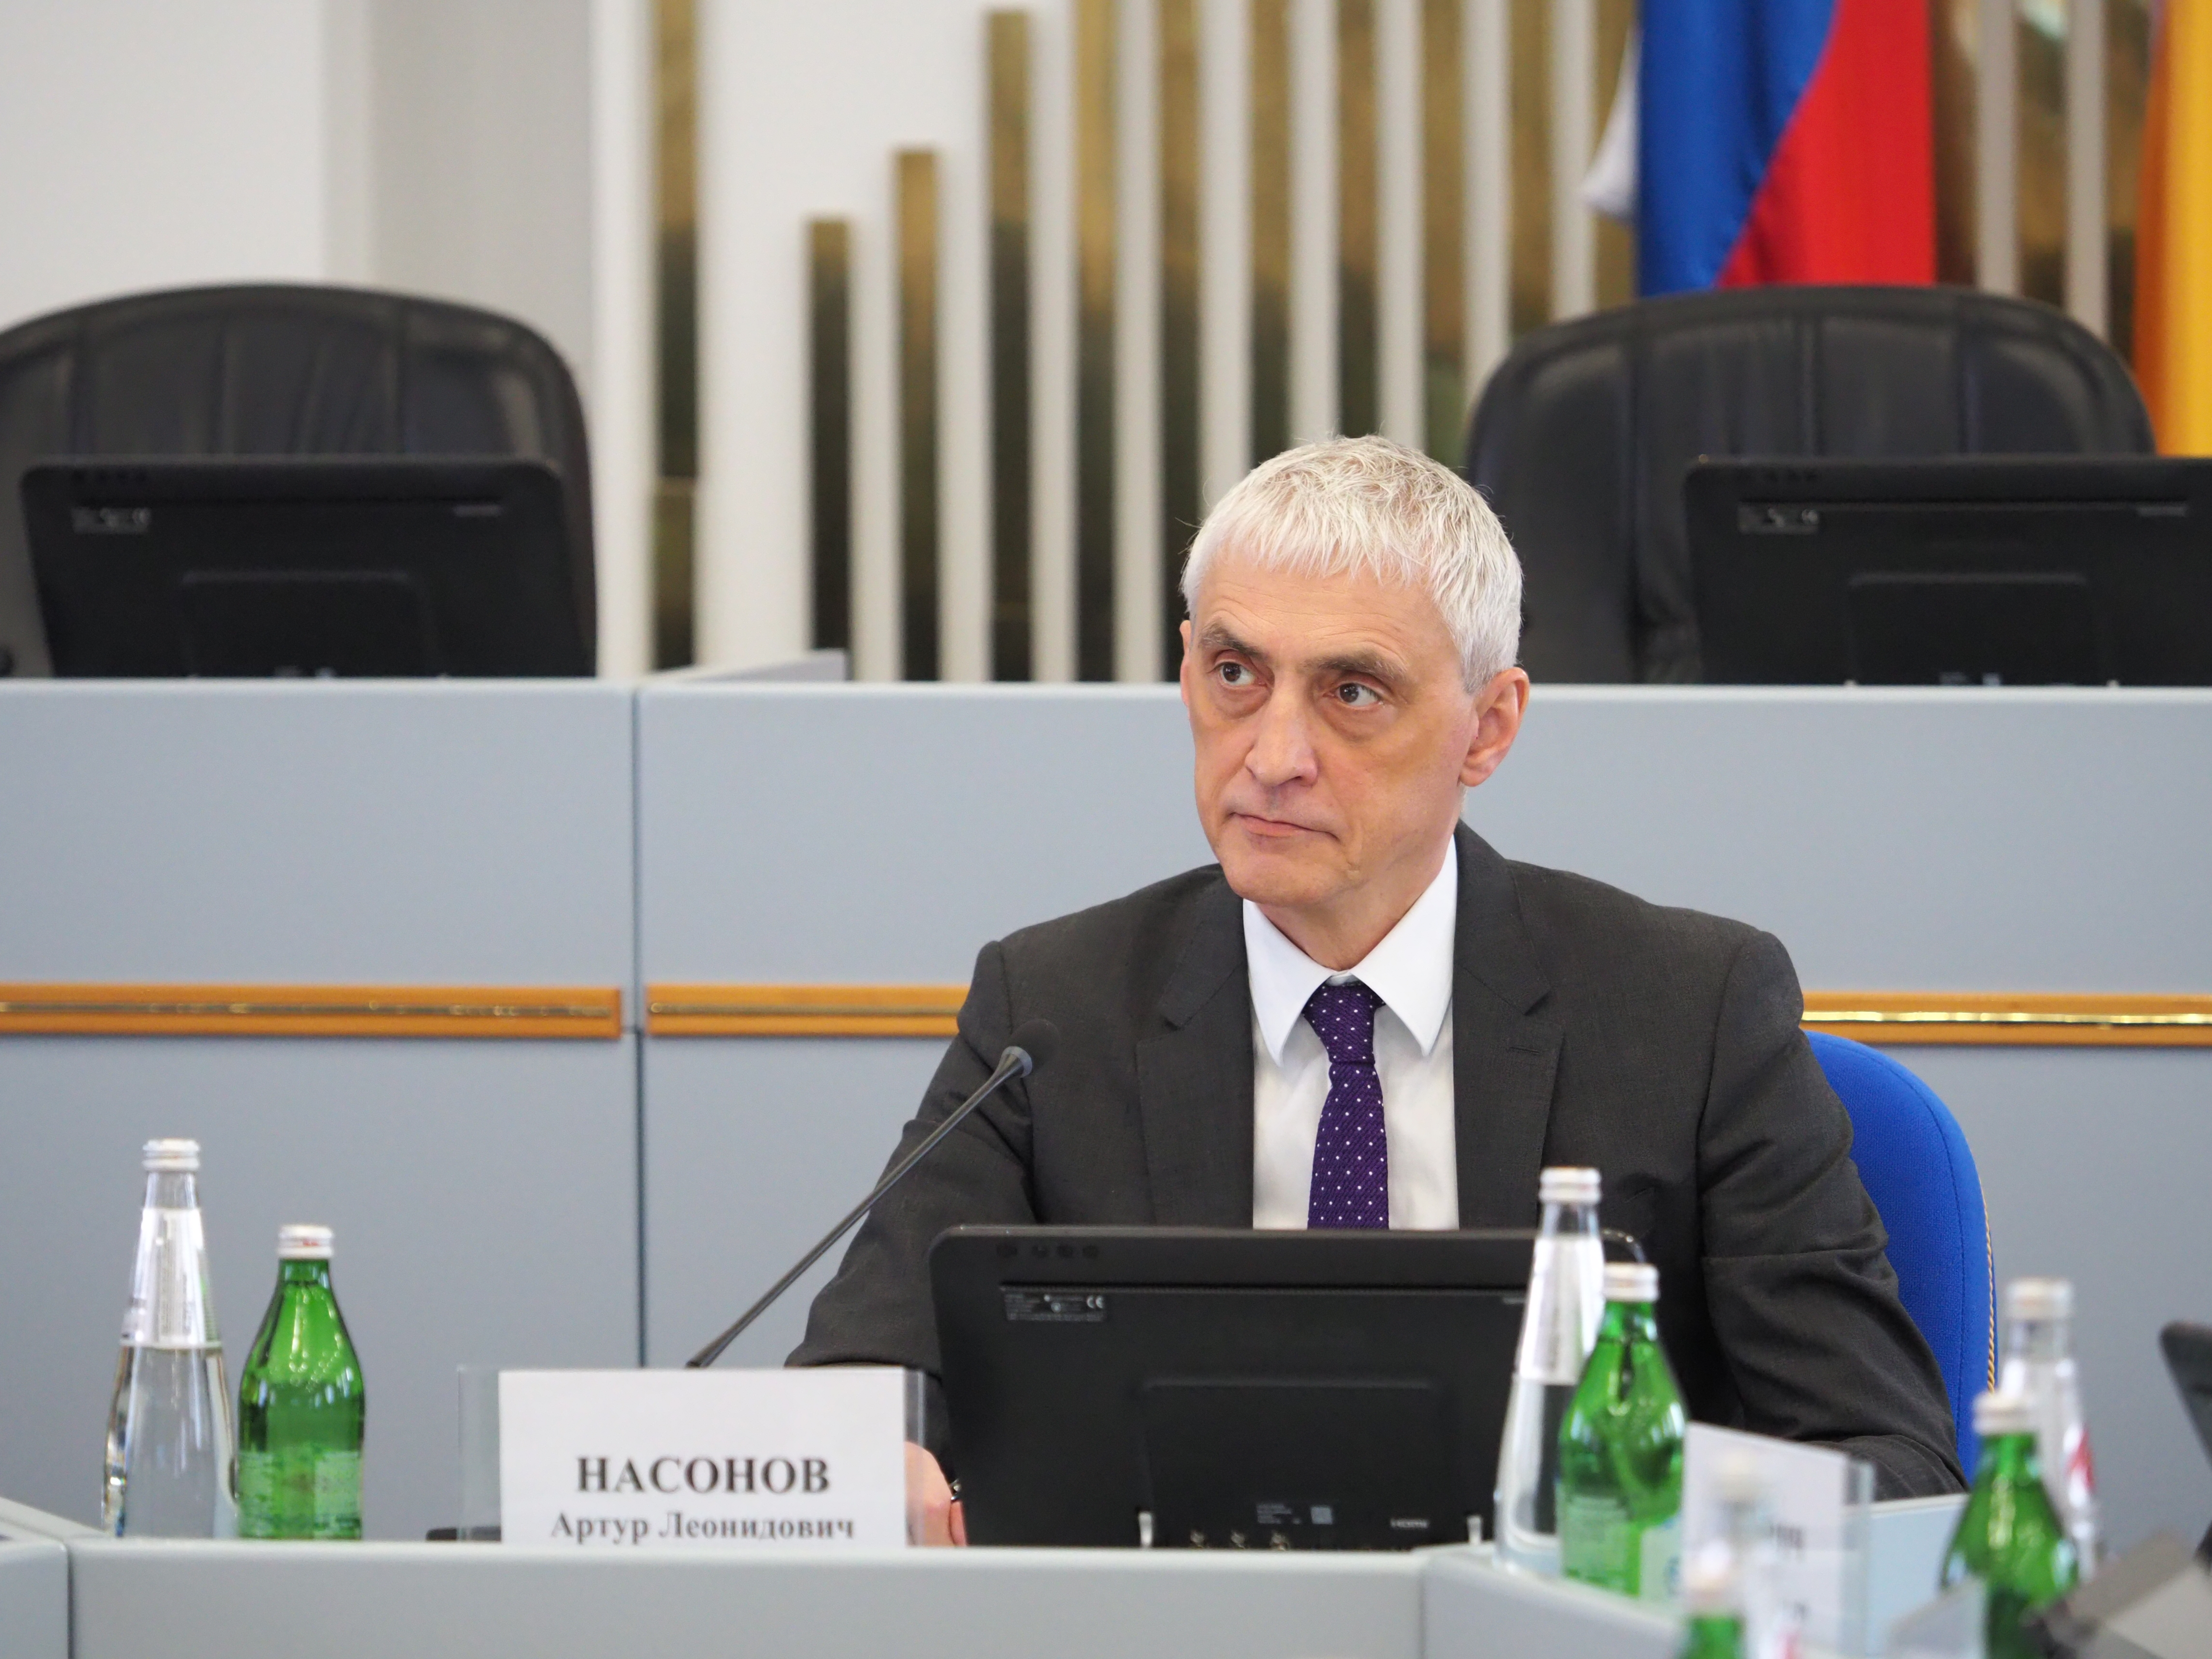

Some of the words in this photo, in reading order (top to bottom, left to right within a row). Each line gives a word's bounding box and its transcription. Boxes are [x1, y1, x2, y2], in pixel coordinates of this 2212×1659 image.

[577, 1456, 830, 1493] НАСОНОВ
[551, 1512, 649, 1545] Артур
[658, 1511, 854, 1541] Леонидович
